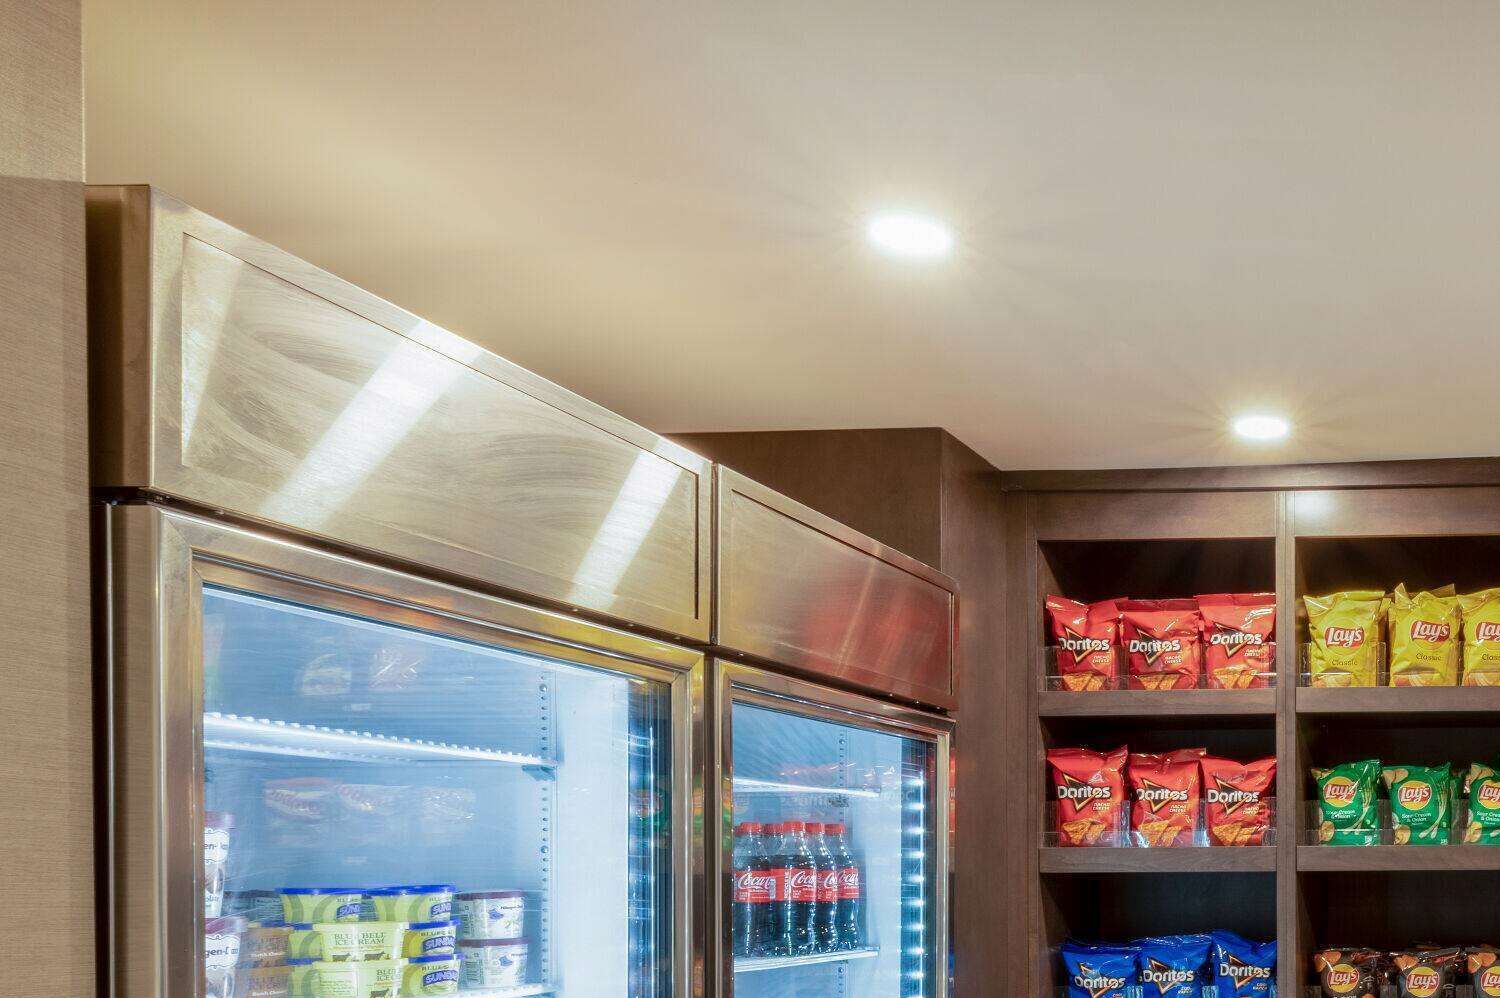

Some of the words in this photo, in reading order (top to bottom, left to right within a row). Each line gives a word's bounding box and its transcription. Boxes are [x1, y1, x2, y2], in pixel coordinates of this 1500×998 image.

[1326, 627, 1363, 647] Lay's
[1412, 620, 1449, 641] Lay's
[1059, 637, 1110, 652] Doritos
[1130, 639, 1181, 653] Doritos
[1210, 633, 1262, 647] Doritos
[1331, 659, 1358, 667] Classic
[1057, 786, 1112, 800] Doritos
[1136, 788, 1189, 801] Doritos
[1208, 789, 1260, 804] Doritos
[1401, 786, 1430, 804] Lay's
[1143, 970, 1194, 983] Doritos
[1220, 964, 1271, 977] Doritos
[1329, 969, 1359, 986] Lay's
[1074, 976, 1125, 989] Doritos
[1407, 973, 1439, 989] Lay's
